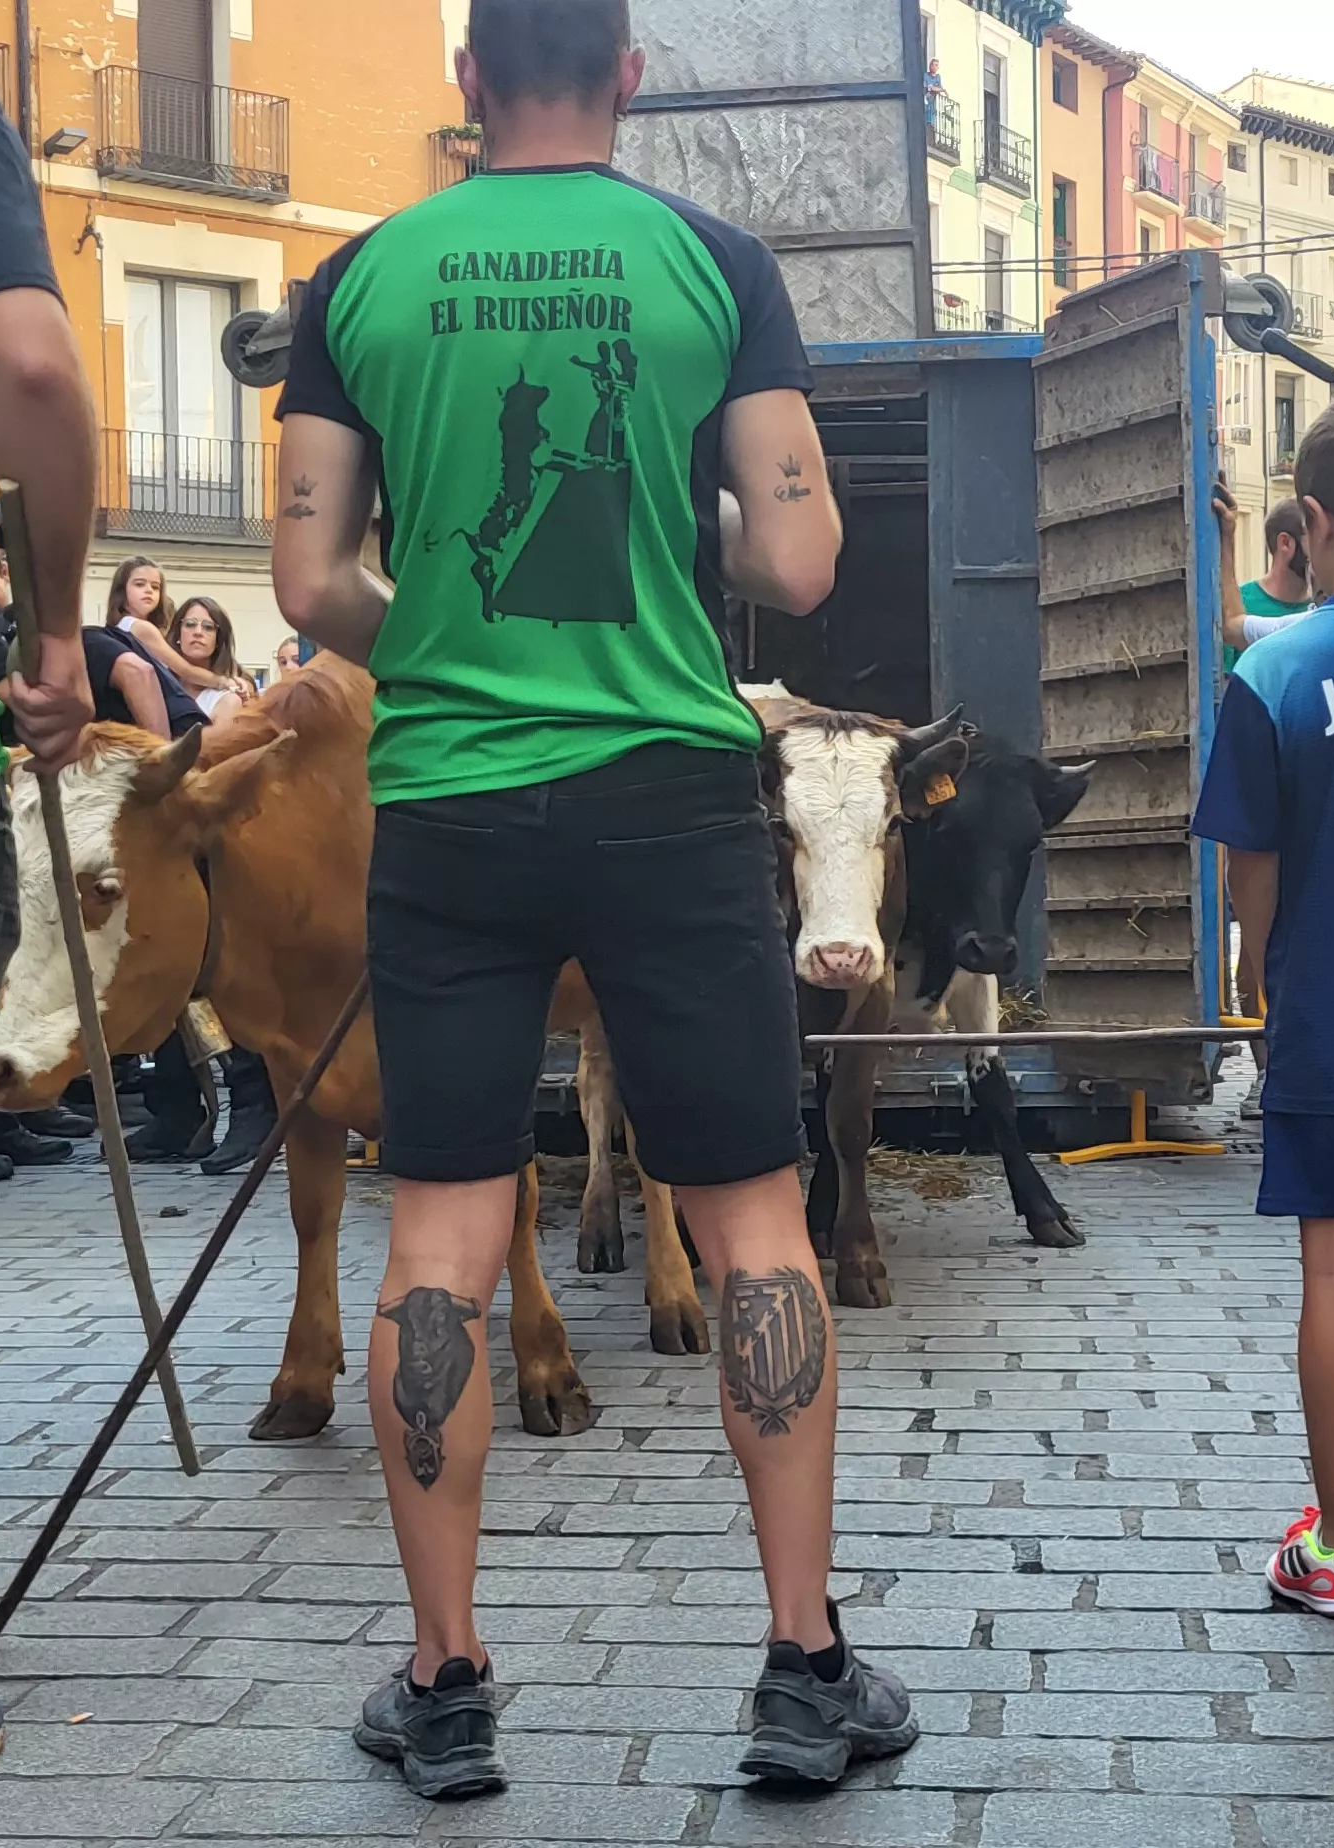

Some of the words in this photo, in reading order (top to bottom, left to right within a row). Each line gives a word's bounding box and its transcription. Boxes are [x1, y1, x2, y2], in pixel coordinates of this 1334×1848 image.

[438, 243, 625, 283] GANADERÍA
[429, 297, 463, 336] EL
[474, 287, 633, 333] RUISEÑOR
